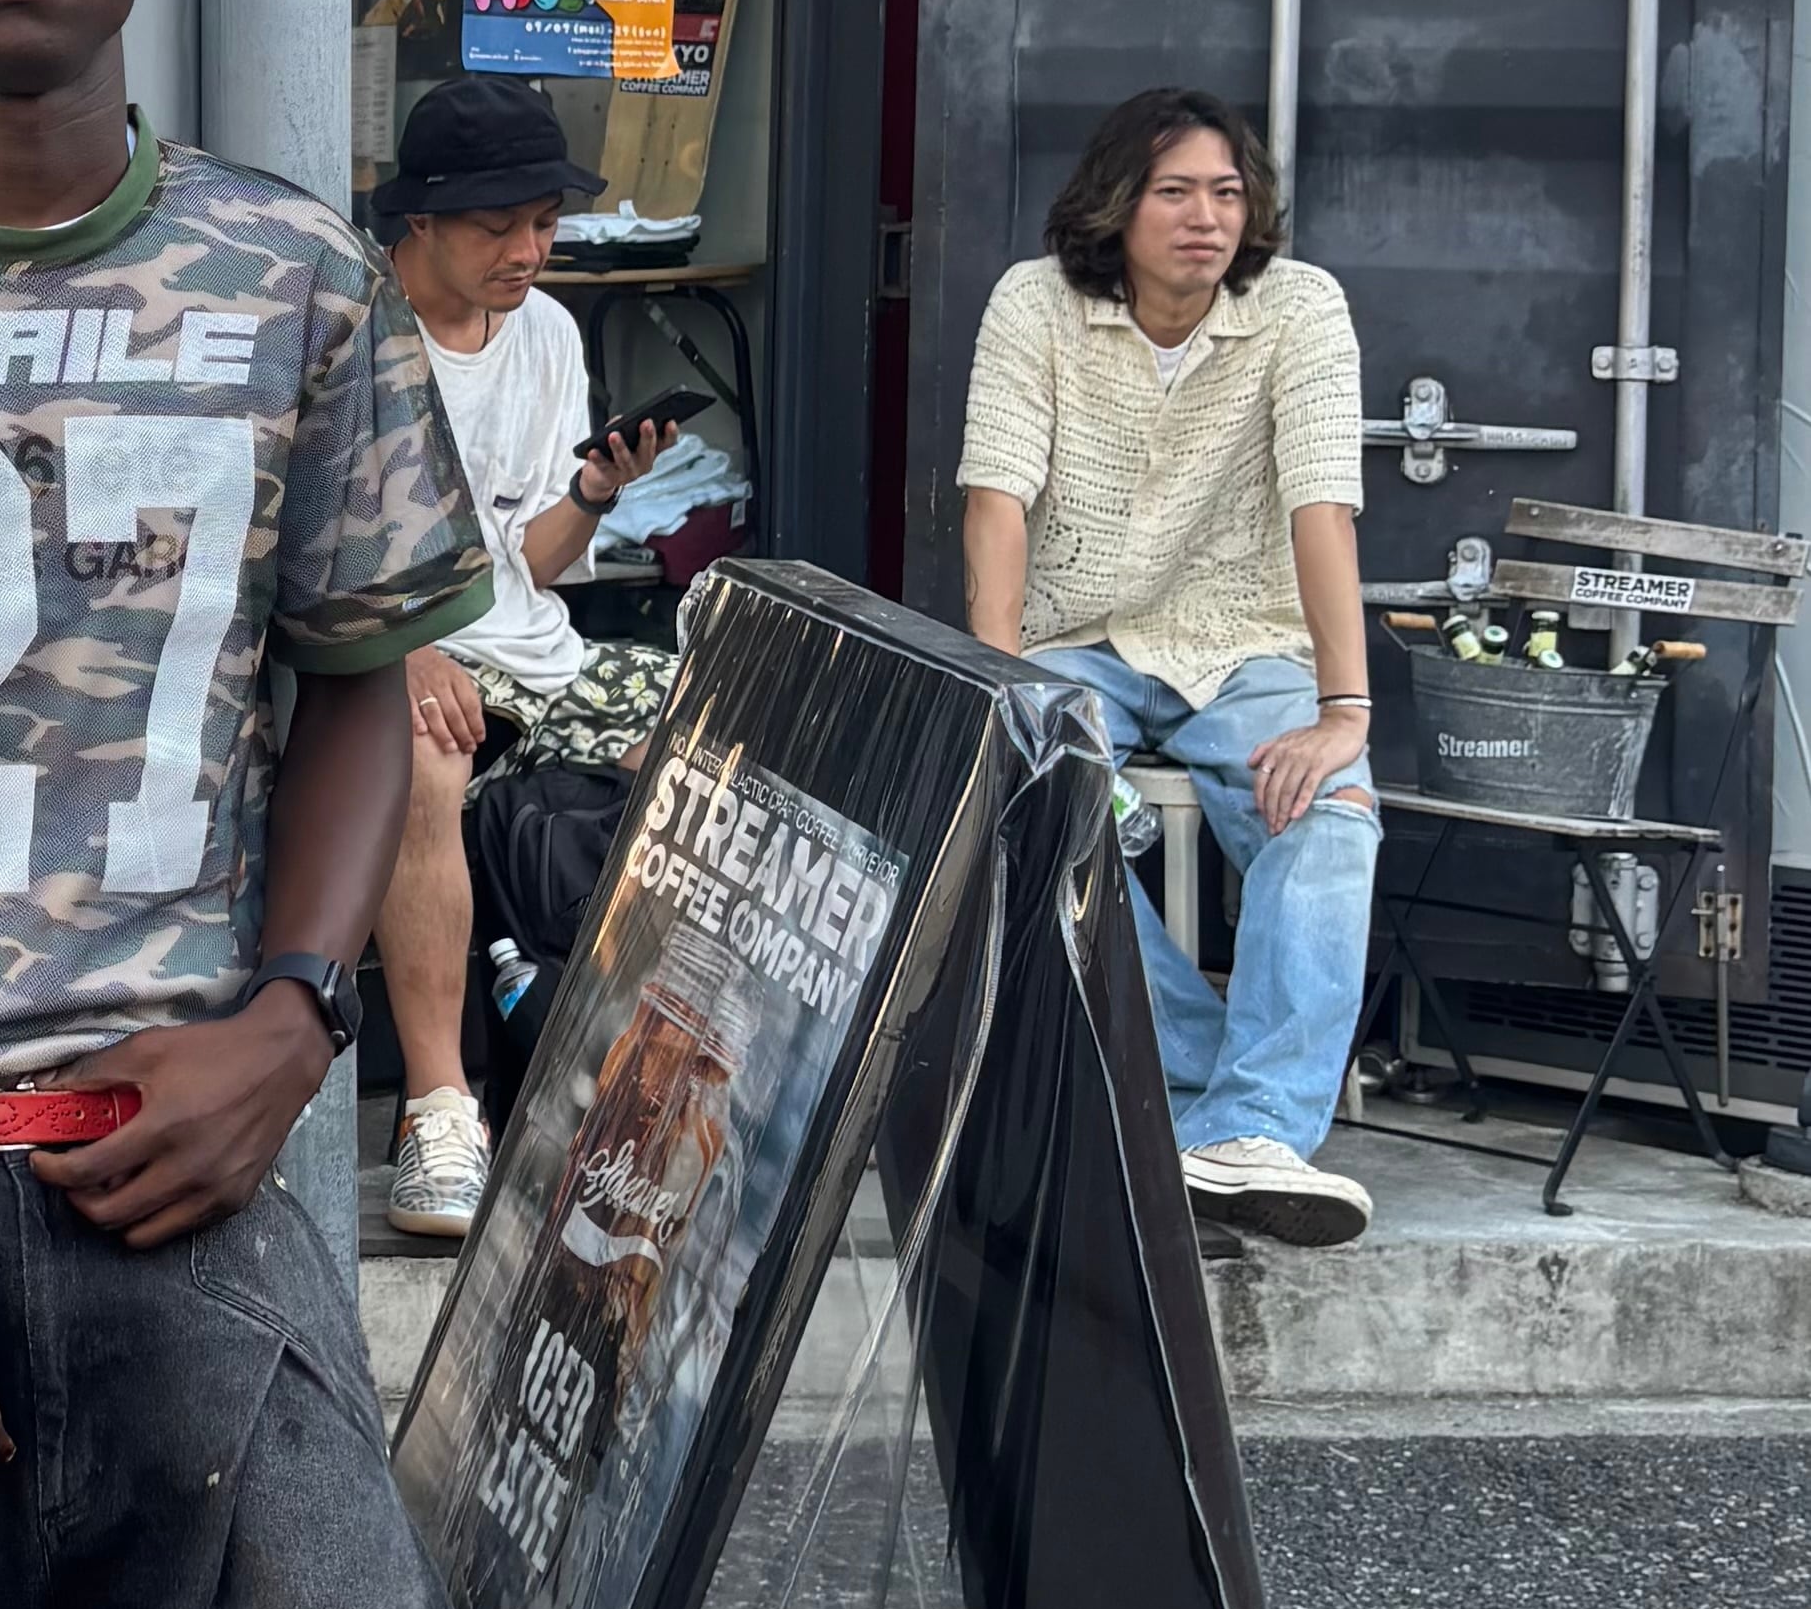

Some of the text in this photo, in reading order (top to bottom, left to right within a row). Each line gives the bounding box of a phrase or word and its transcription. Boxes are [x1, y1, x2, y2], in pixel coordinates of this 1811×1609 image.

[621, 80, 708, 95] COFFEE COMPANY
[1575, 587, 1688, 608] COFFEE COMPANY
[1577, 571, 1691, 598] STREAMER
[646, 756, 888, 973] STREAMER
[795, 810, 839, 852] COFFEE
[627, 832, 859, 1025] COFFEE COMPANY
[517, 1317, 596, 1462] ICED
[477, 1410, 570, 1574] LATTE
